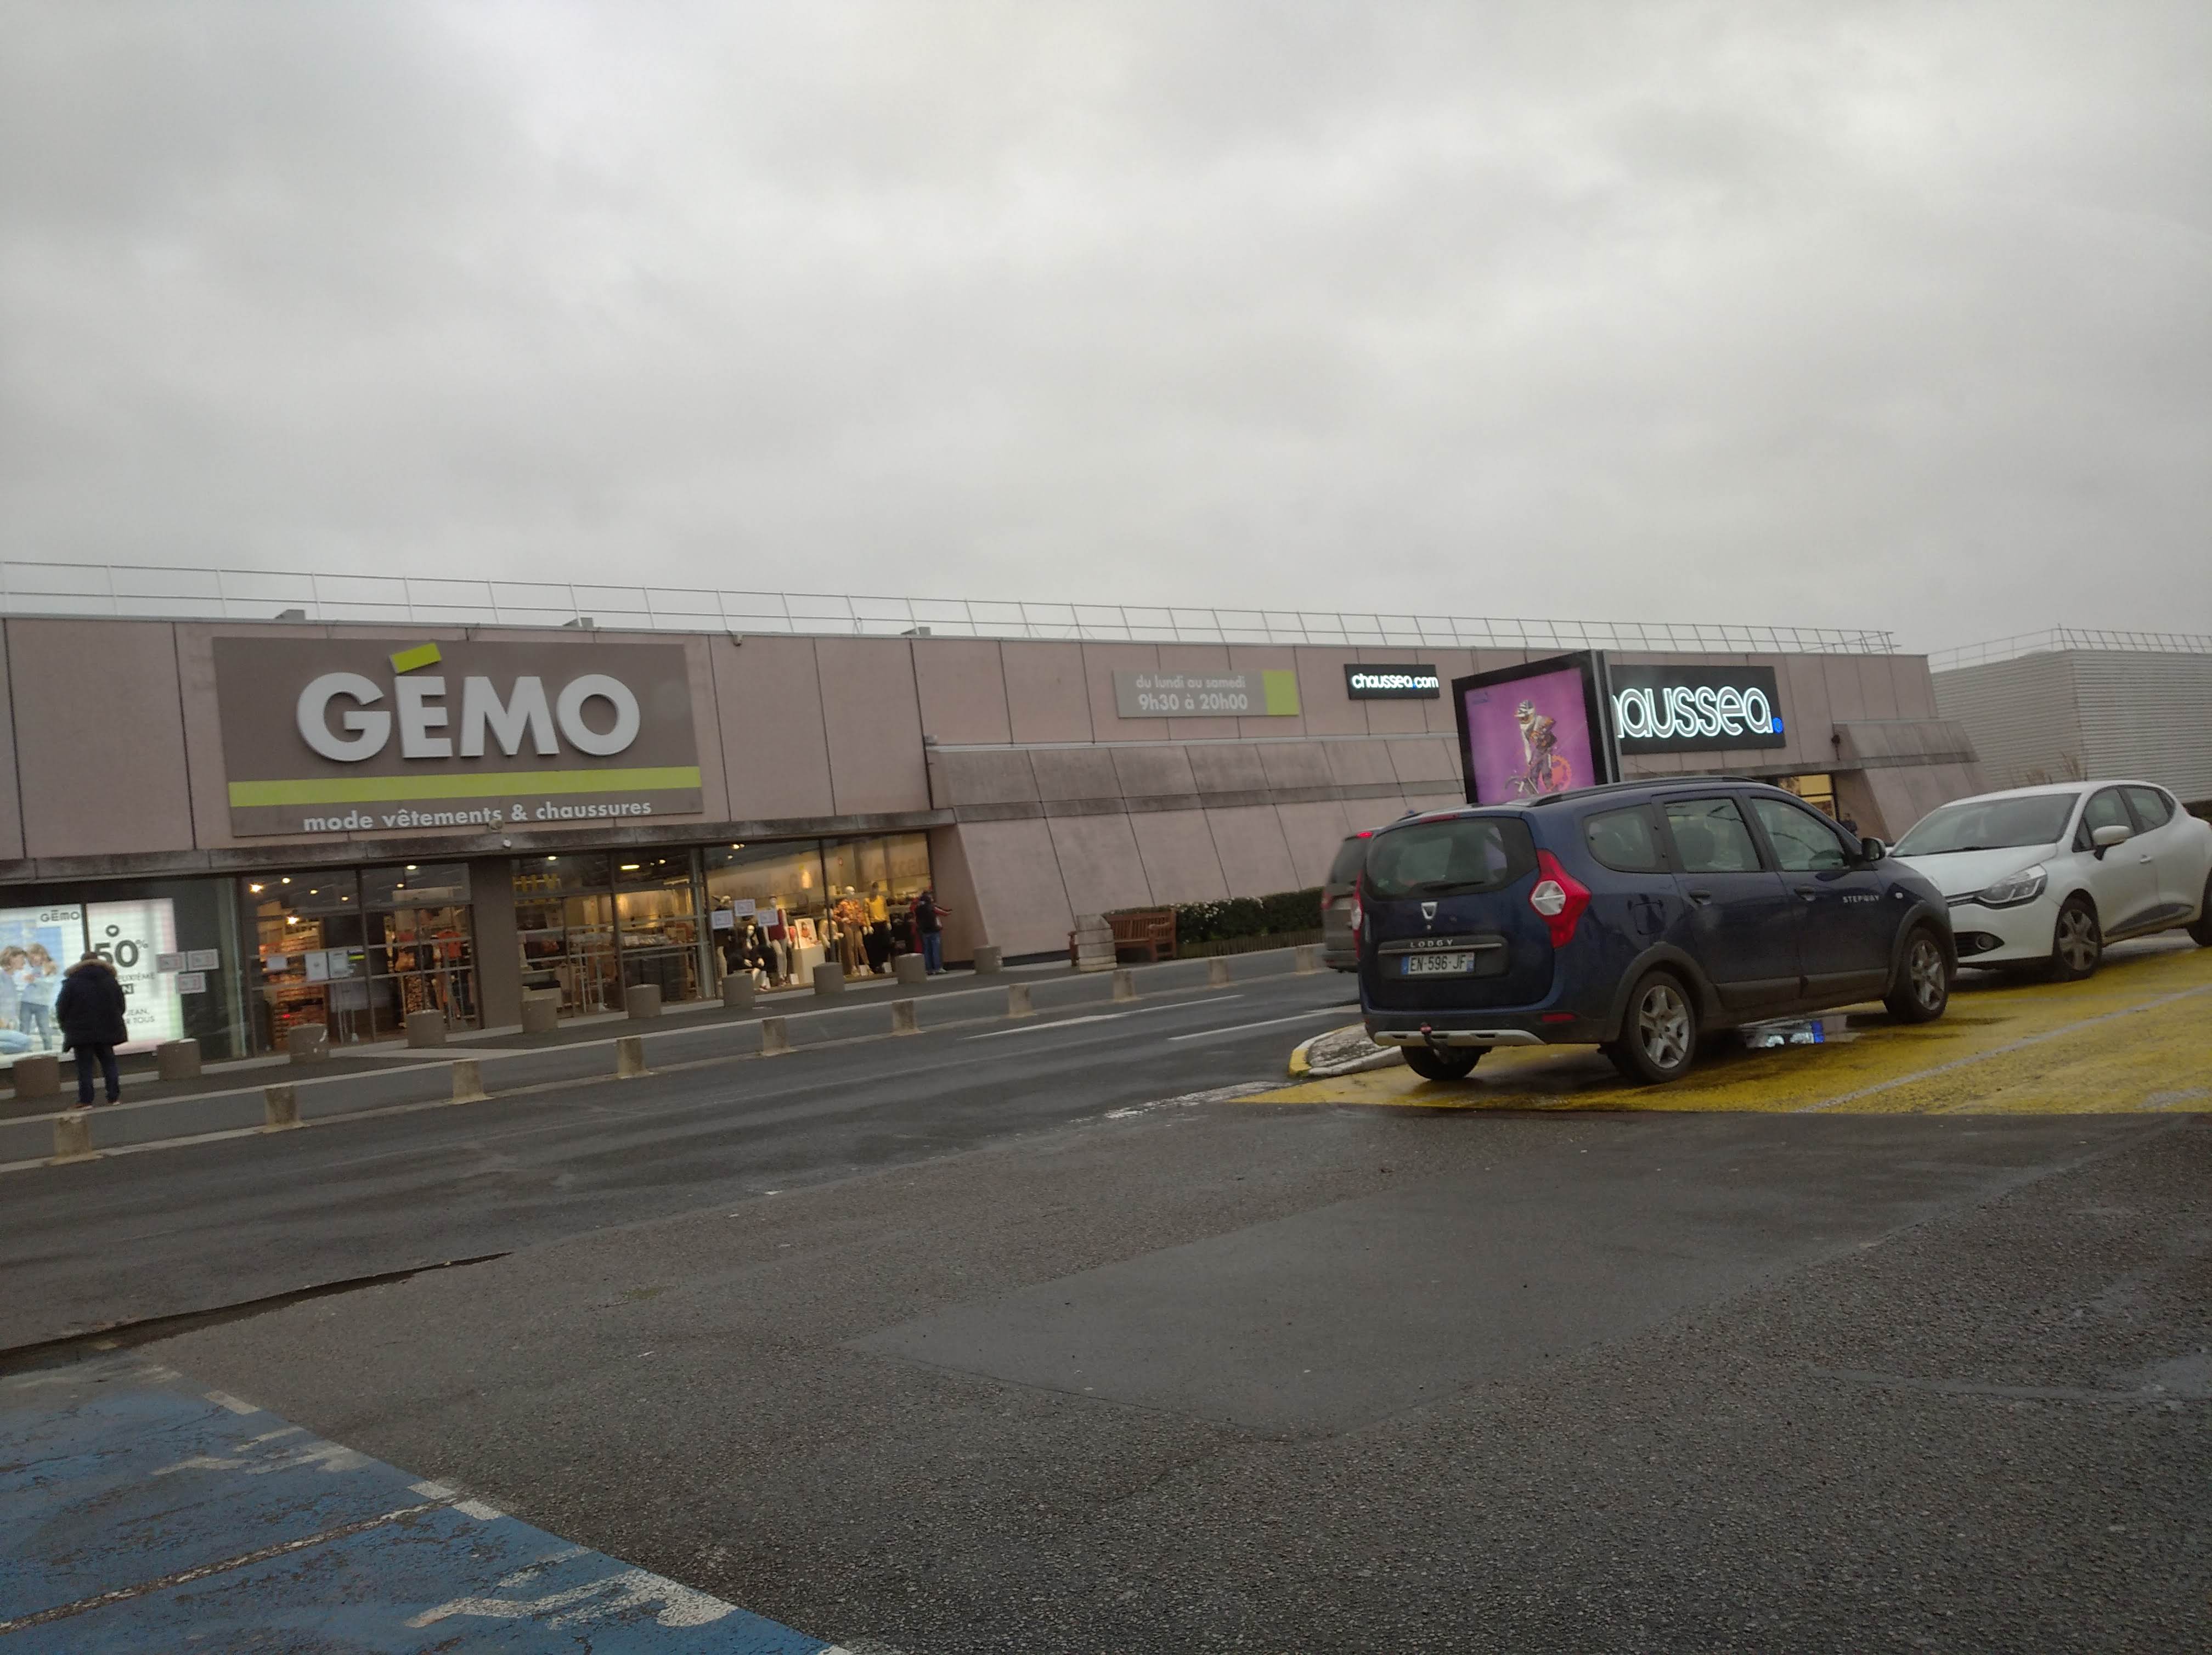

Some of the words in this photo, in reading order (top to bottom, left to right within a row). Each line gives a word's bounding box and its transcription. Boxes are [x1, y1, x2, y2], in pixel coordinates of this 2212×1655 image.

[1136, 674, 1151, 688] du
[1154, 674, 1184, 688] lundi
[1188, 679, 1203, 688] au
[1206, 675, 1246, 688] samedi
[1352, 673, 1439, 689] chaussea.com
[1138, 694, 1180, 710] 9h30
[1184, 693, 1194, 710] à
[1200, 693, 1248, 710] 20h00
[303, 810, 374, 831] mode
[382, 807, 502, 828] vêtements
[511, 804, 528, 821] &
[536, 801, 652, 820] chaussures
[1410, 939, 1453, 948] LODGY
